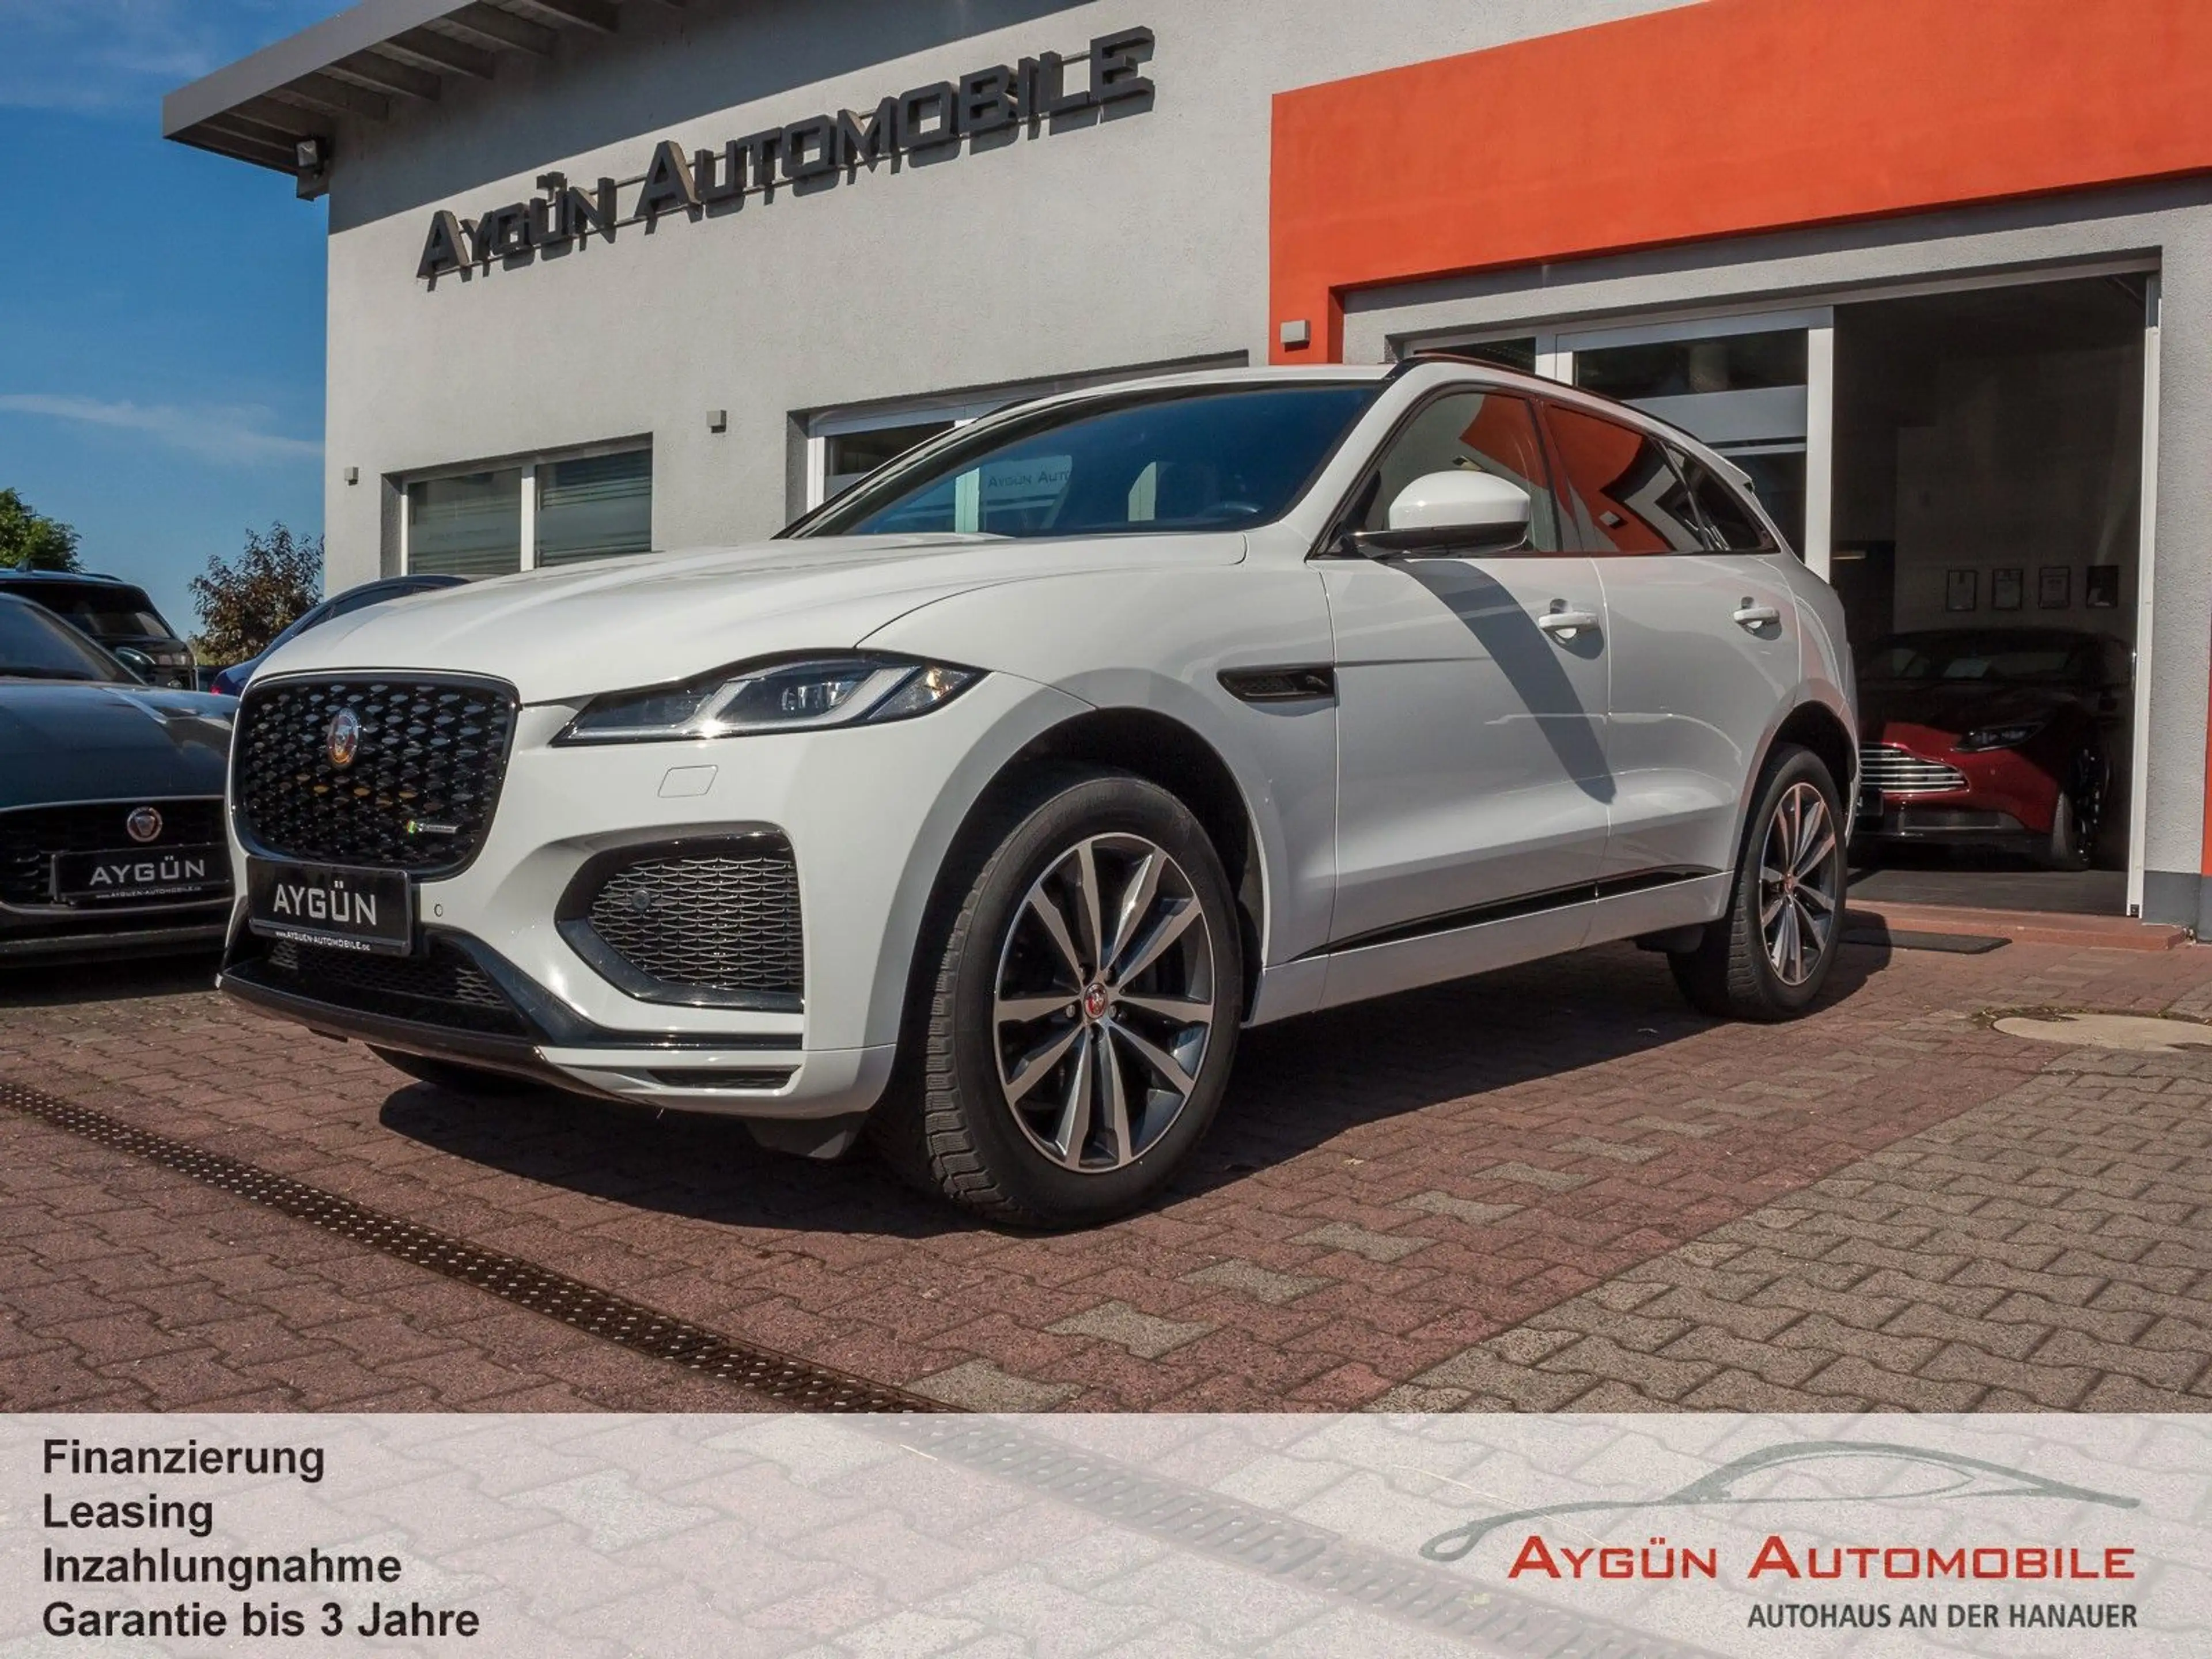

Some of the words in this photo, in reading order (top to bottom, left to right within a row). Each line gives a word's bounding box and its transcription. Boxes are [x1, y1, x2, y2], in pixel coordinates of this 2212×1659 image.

[634, 25, 1155, 218] AUTOMOBILE
[89, 855, 204, 885] AYGÜN
[274, 880, 377, 926] AYGÜN
